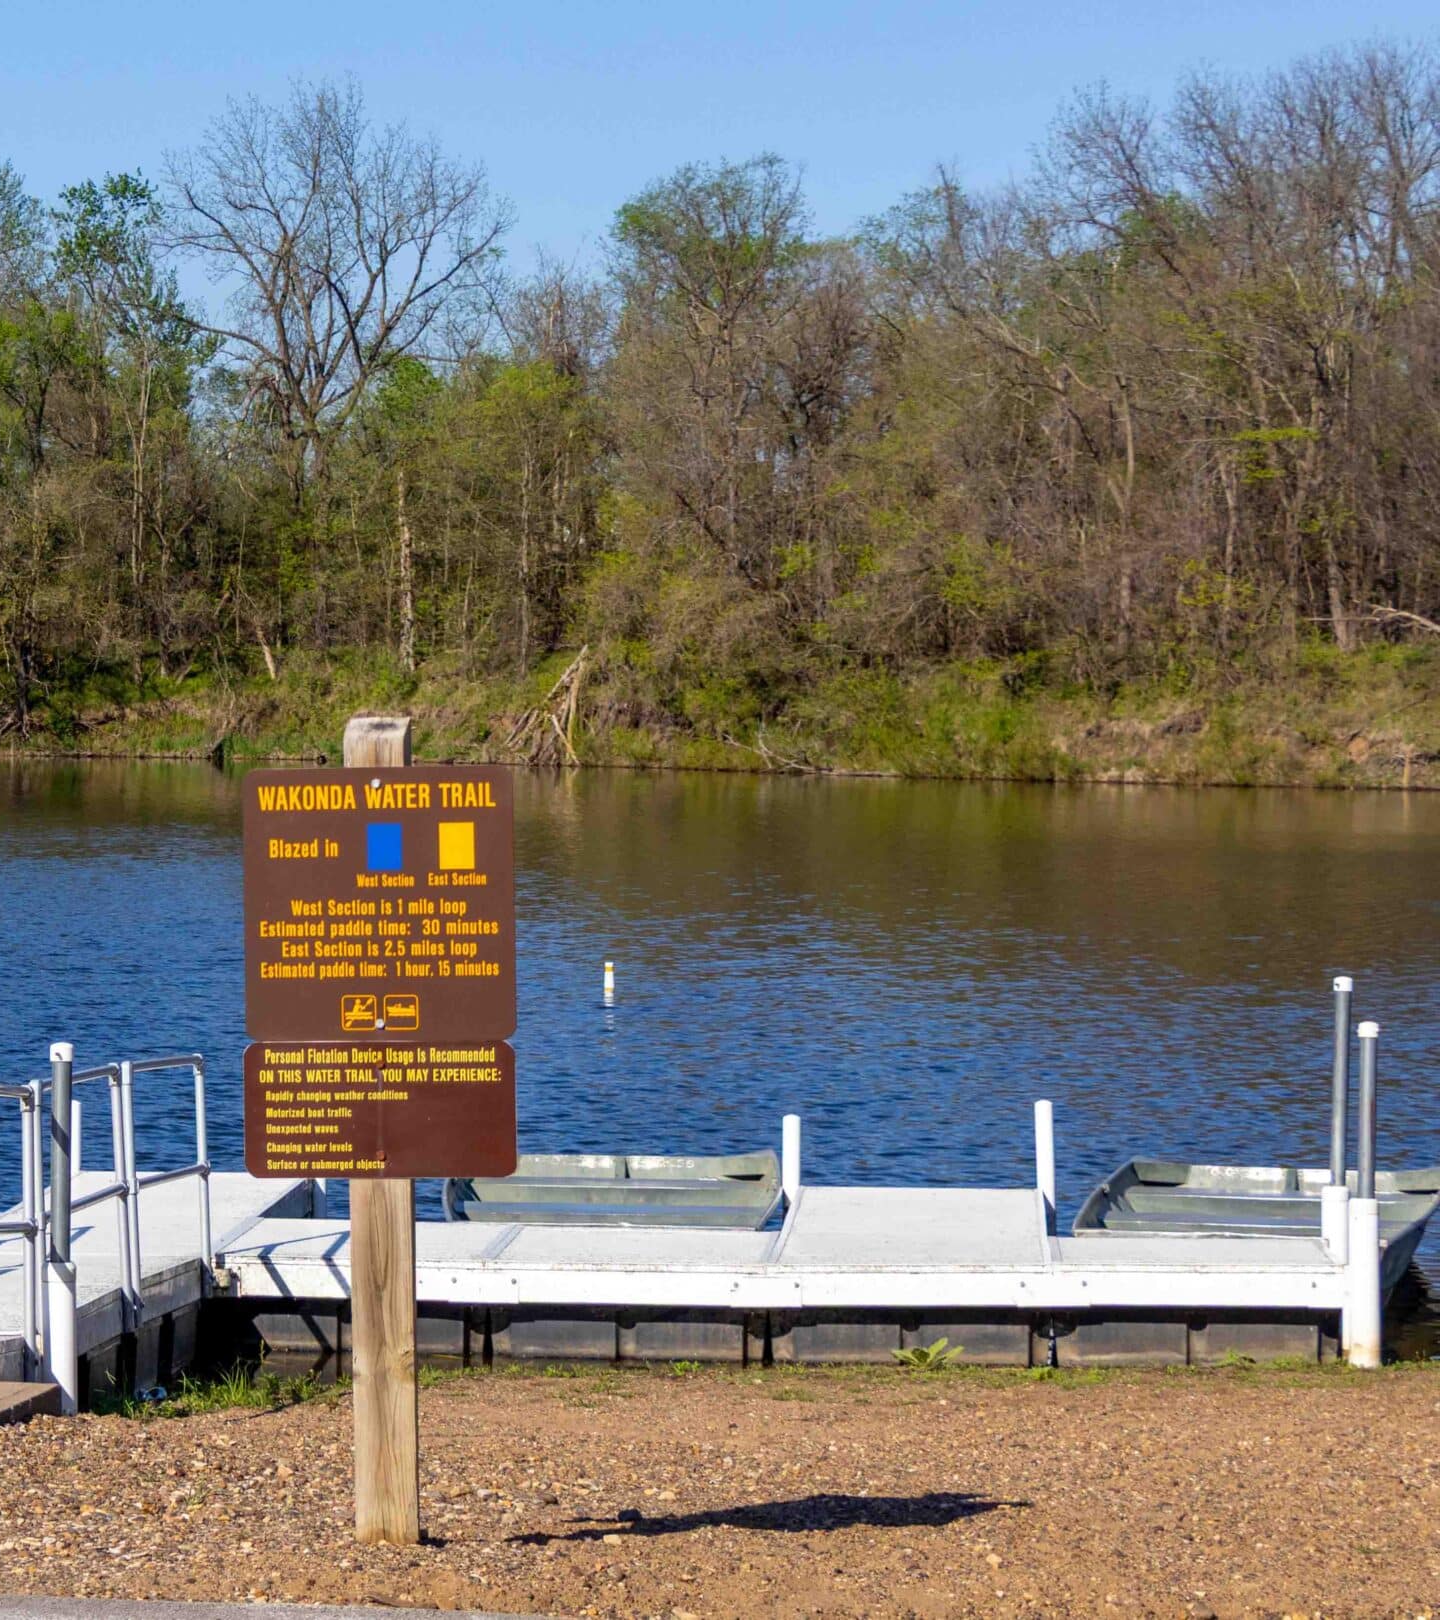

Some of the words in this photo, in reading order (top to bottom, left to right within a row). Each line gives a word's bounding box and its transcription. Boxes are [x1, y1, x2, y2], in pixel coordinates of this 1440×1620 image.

[258, 784, 356, 811] WAKONDA
[365, 783, 430, 809] WATER
[439, 782, 496, 807] TRAIL
[269, 838, 318, 859] Blazed
[324, 839, 339, 857] in
[356, 874, 378, 888] West
[381, 874, 415, 887] Section
[428, 873, 448, 886] East
[451, 872, 487, 886] Section
[291, 900, 322, 916] West
[327, 899, 376, 916] Section
[380, 900, 393, 915] is
[397, 898, 404, 915] 1
[408, 899, 434, 915] mile
[439, 899, 467, 917] loop
[260, 920, 325, 938] Estimated
[329, 920, 373, 938] paddle
[377, 921, 410, 936] time:
[422, 919, 440, 935] 30
[445, 920, 499, 935] minutes
[281, 940, 309, 958] East
[314, 940, 363, 957] Section
[384, 939, 406, 957] 2.5
[410, 940, 445, 956] miles
[450, 939, 478, 957] loop
[260, 962, 316, 978] Estimated
[319, 962, 355, 979] paddle
[358, 962, 387, 977] time:
[396, 960, 401, 976] 1
[438, 959, 451, 976] 15
[455, 961, 500, 976] minutes
[264, 1049, 305, 1064] Personal
[307, 1049, 350, 1063] Flotation
[351, 1049, 383, 1063] Device
[386, 1048, 415, 1065] Usage
[430, 1048, 495, 1063] Recommended
[259, 1070, 274, 1083] ON
[278, 1069, 302, 1083] THIS
[306, 1069, 341, 1082] WATER
[345, 1068, 377, 1083] TRAIL,
[382, 1069, 403, 1082] YOU
[406, 1069, 428, 1081] MAY
[432, 1068, 501, 1082] EXPERIENCE:
[265, 1092, 294, 1101] Rapidly
[297, 1092, 331, 1102] changing
[334, 1091, 365, 1101] weather
[366, 1090, 408, 1100] conditions
[266, 1108, 307, 1117] Motorized
[308, 1109, 327, 1118] boat
[327, 1107, 352, 1117] traffic
[266, 1124, 313, 1134] Unexpected
[314, 1125, 338, 1133] waves
[267, 1142, 302, 1154] Changing
[303, 1144, 326, 1152] water
[329, 1143, 352, 1152] levels
[267, 1160, 298, 1169] Surface
[300, 1161, 308, 1169] or
[312, 1160, 354, 1171] submerged
[356, 1160, 384, 1170] objects
